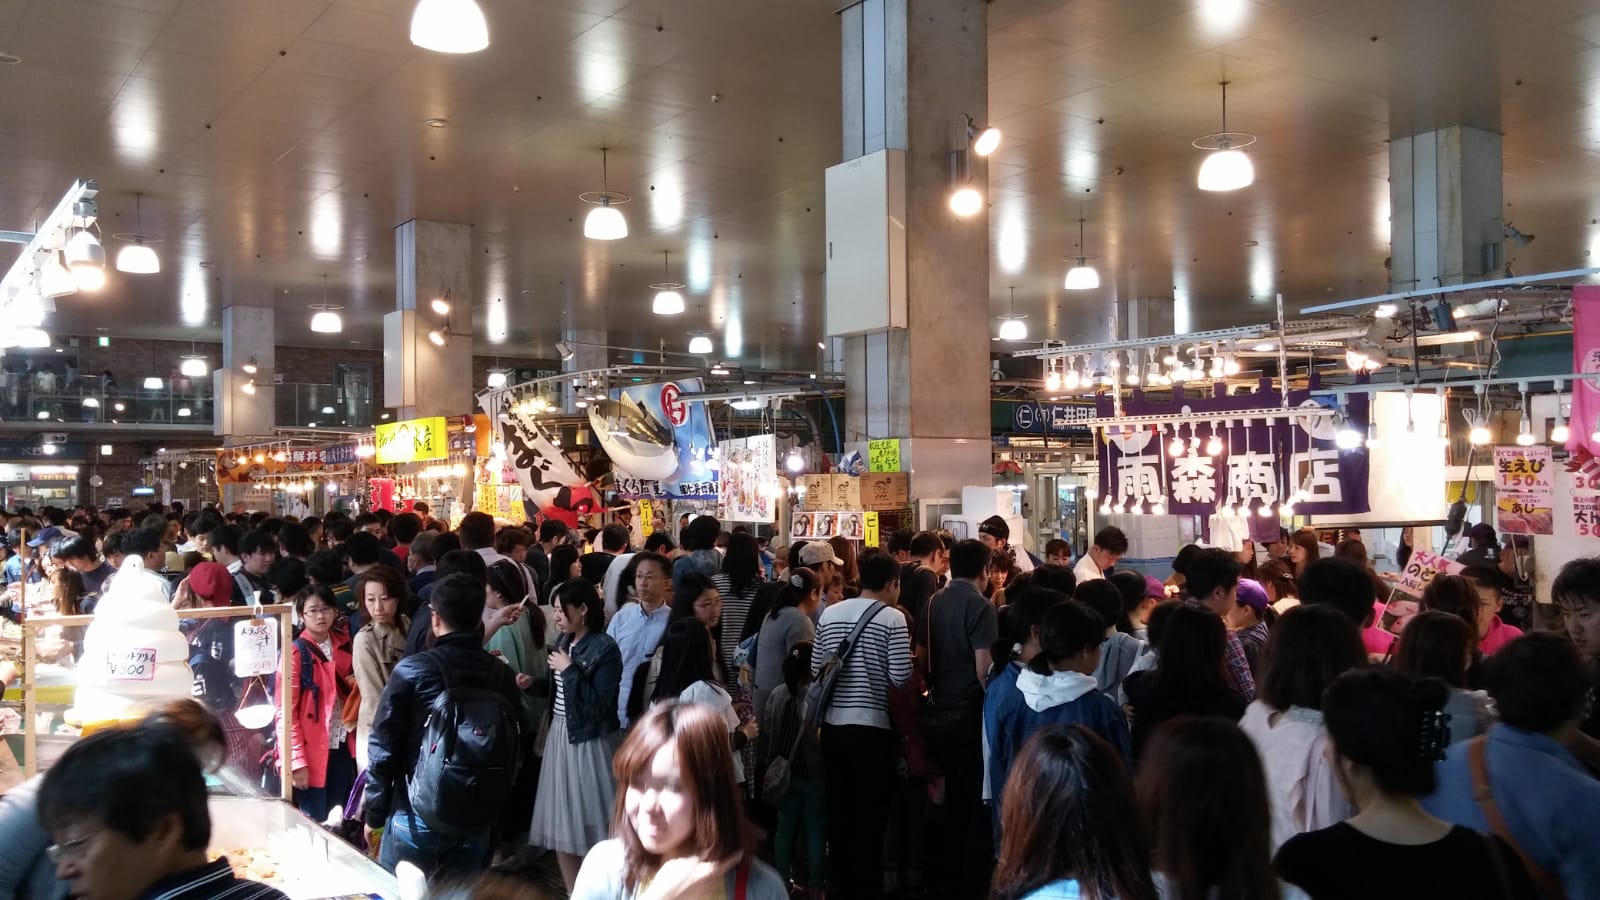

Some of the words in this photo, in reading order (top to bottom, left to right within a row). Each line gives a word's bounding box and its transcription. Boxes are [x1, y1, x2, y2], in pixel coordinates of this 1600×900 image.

[1499, 459, 1545, 473] 生えび
[642, 501, 651, 527] ビール
[1512, 503, 1535, 514] あじ
[866, 514, 877, 547] ビー
